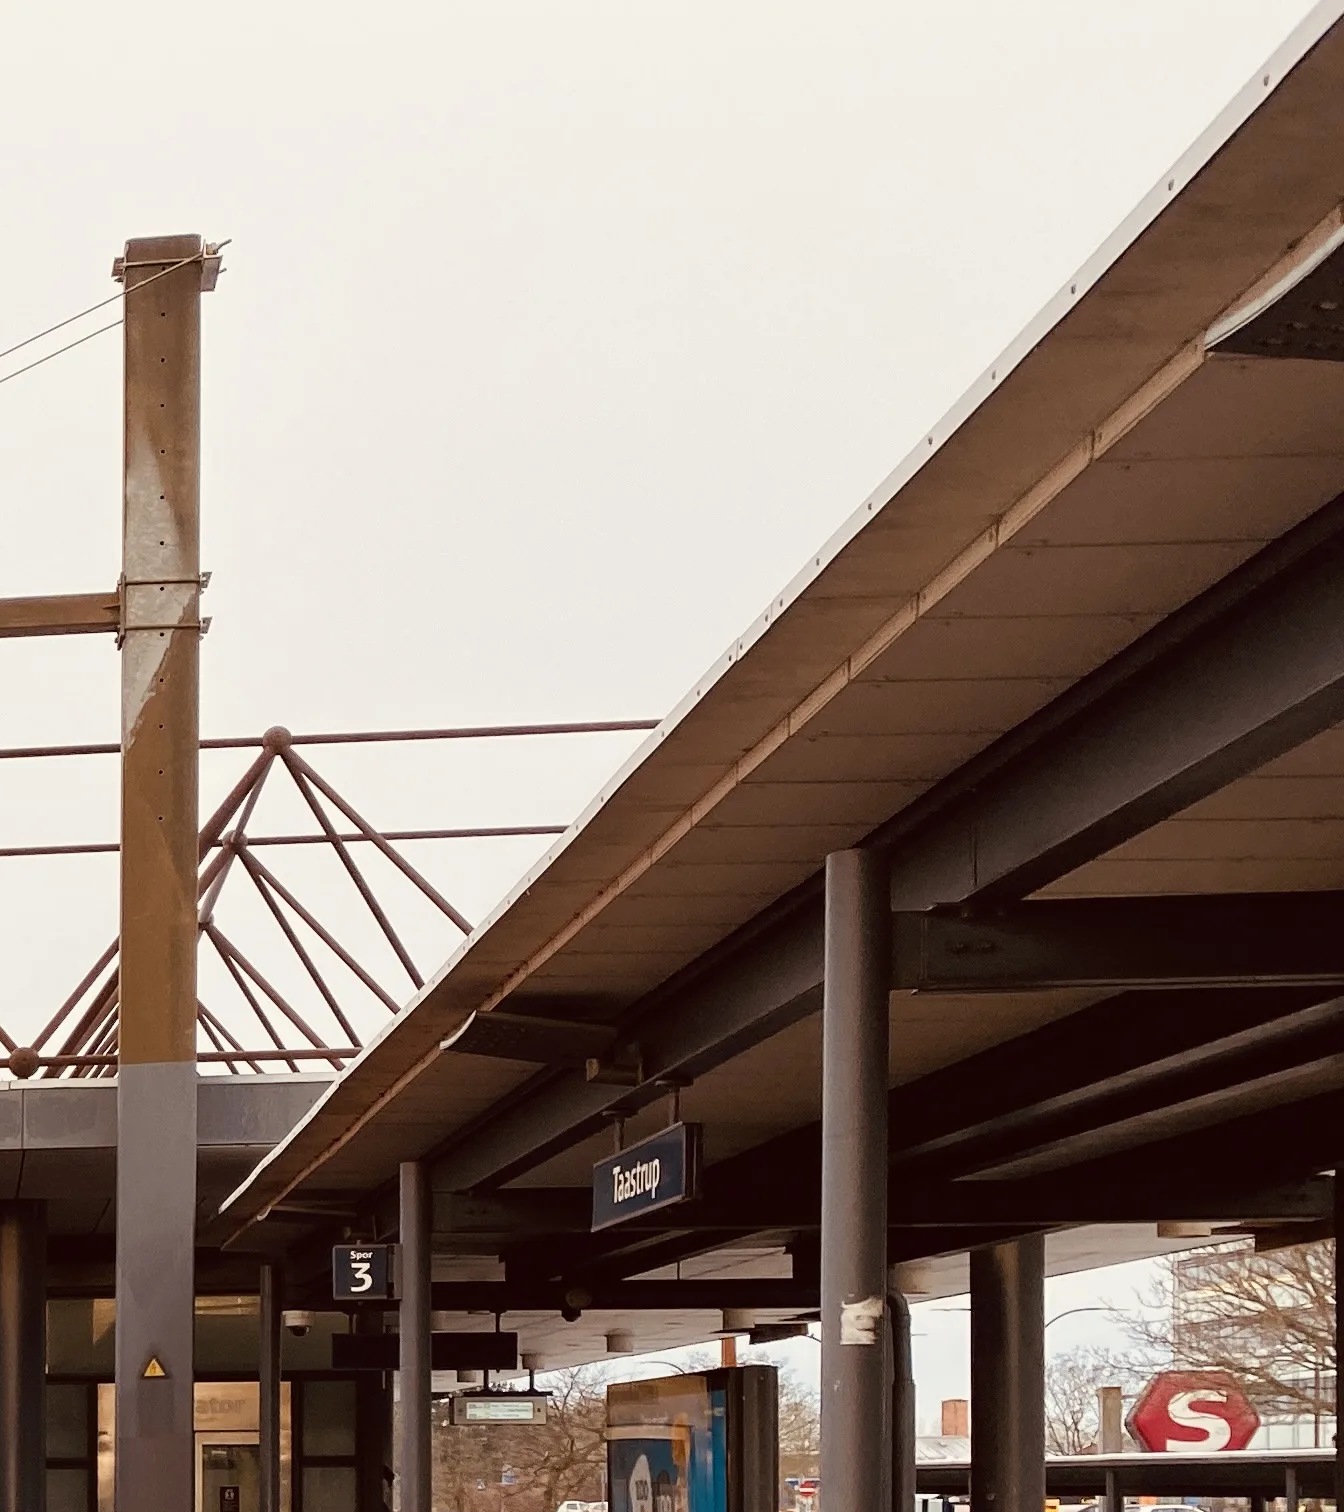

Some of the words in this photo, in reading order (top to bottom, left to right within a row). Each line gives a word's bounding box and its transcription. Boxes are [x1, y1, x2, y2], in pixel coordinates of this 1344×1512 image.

[612, 1158, 660, 1204] Taastrup
[350, 1250, 373, 1260] Spor
[350, 1262, 373, 1293] 3
[1165, 1389, 1231, 1452] S
